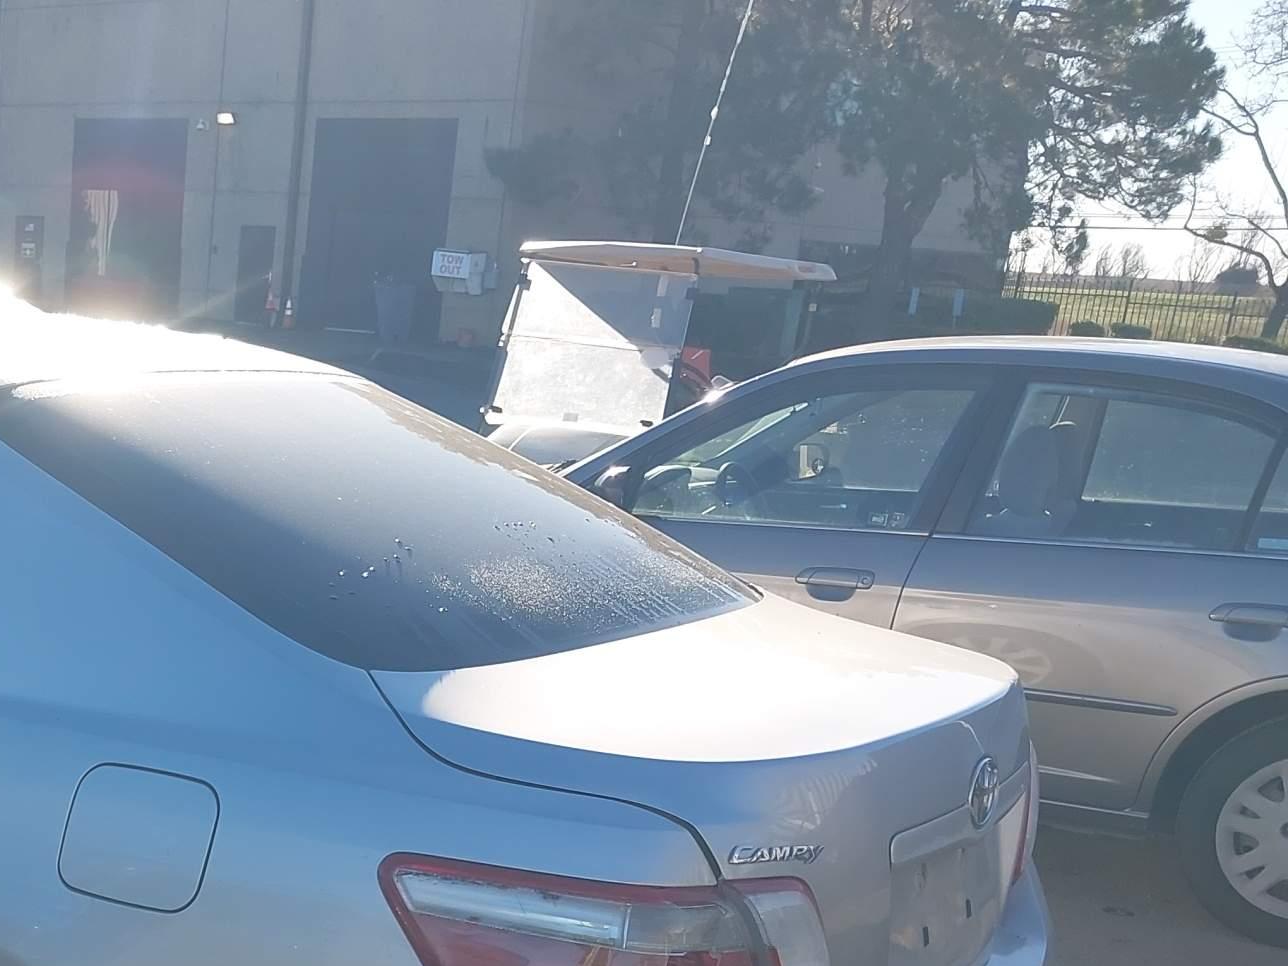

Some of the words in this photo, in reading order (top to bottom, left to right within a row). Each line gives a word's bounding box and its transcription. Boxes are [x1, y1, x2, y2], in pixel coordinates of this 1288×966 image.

[439, 253, 465, 265] TOW
[439, 264, 463, 276] OUT
[727, 844, 825, 865] CAMRY
